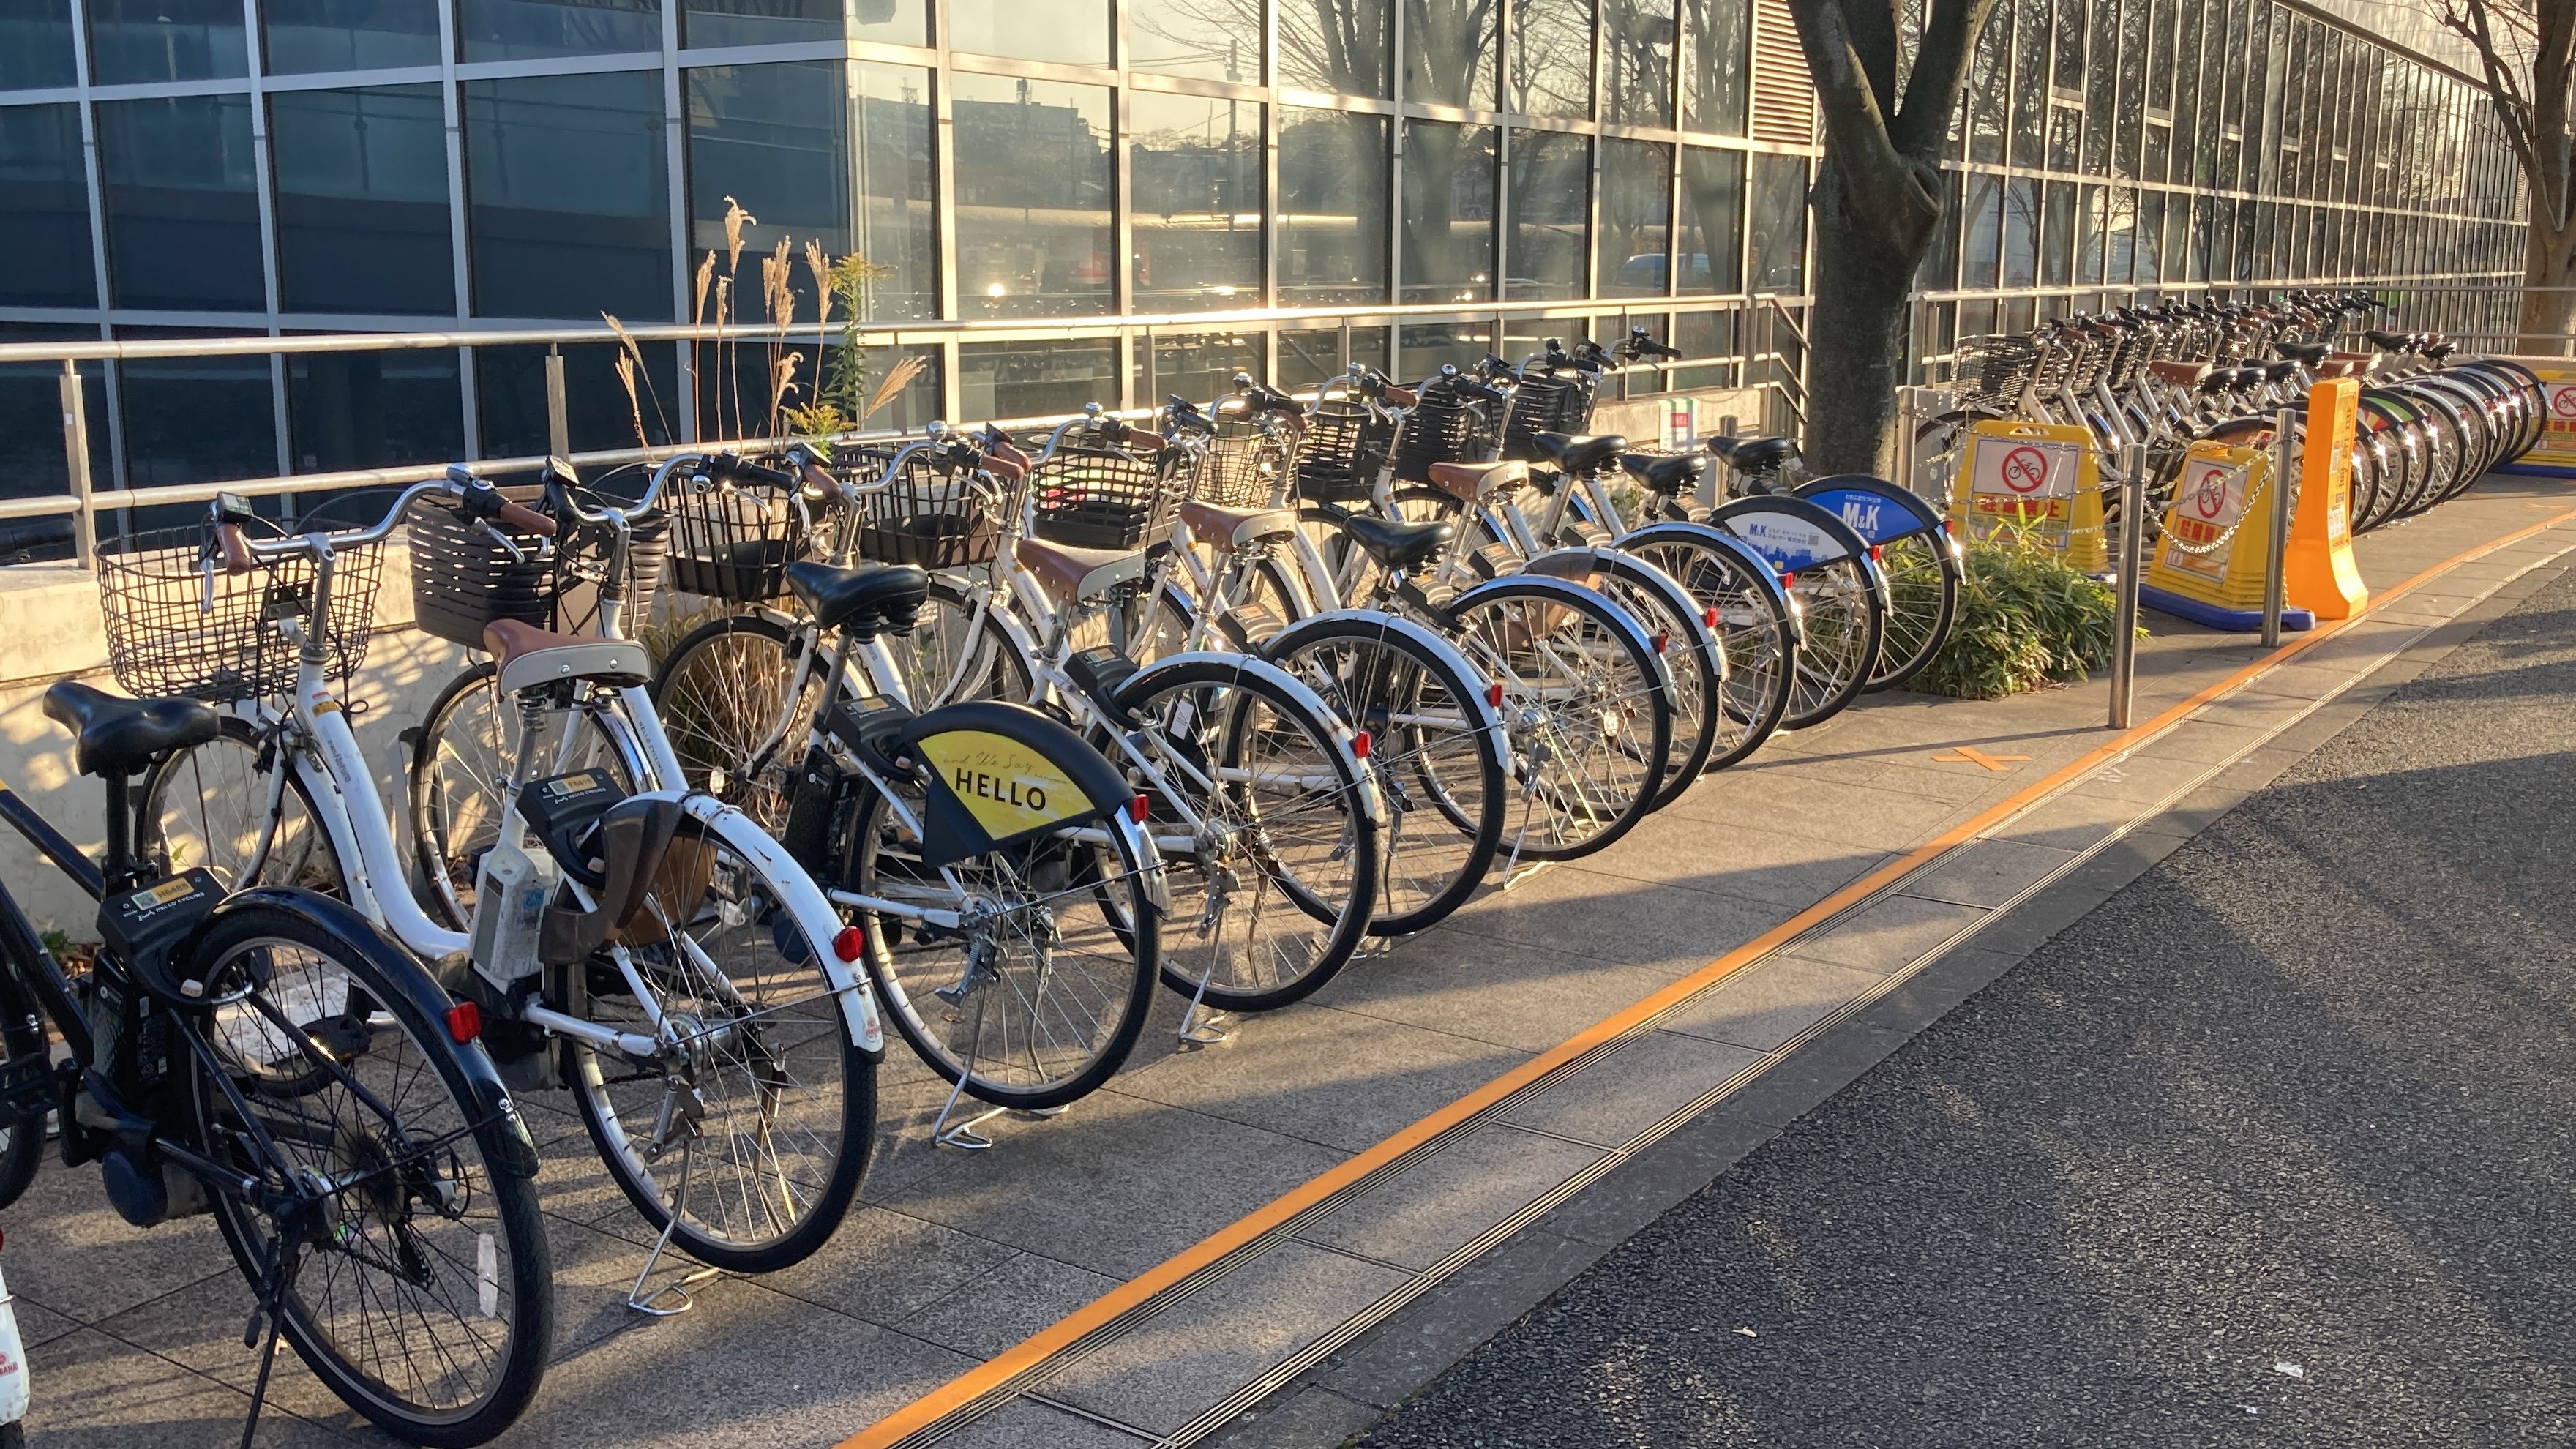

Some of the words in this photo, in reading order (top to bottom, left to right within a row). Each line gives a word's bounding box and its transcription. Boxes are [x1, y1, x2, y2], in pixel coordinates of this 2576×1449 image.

[1843, 502, 1881, 531] M&K
[639, 721, 651, 744] HELLO
[648, 744, 664, 774] CYCLING
[976, 751, 999, 767] We
[1003, 753, 1035, 775] Say
[955, 768, 1046, 812] HELLO
[155, 901, 177, 913] HELLO
[177, 891, 205, 904] CYCLING
